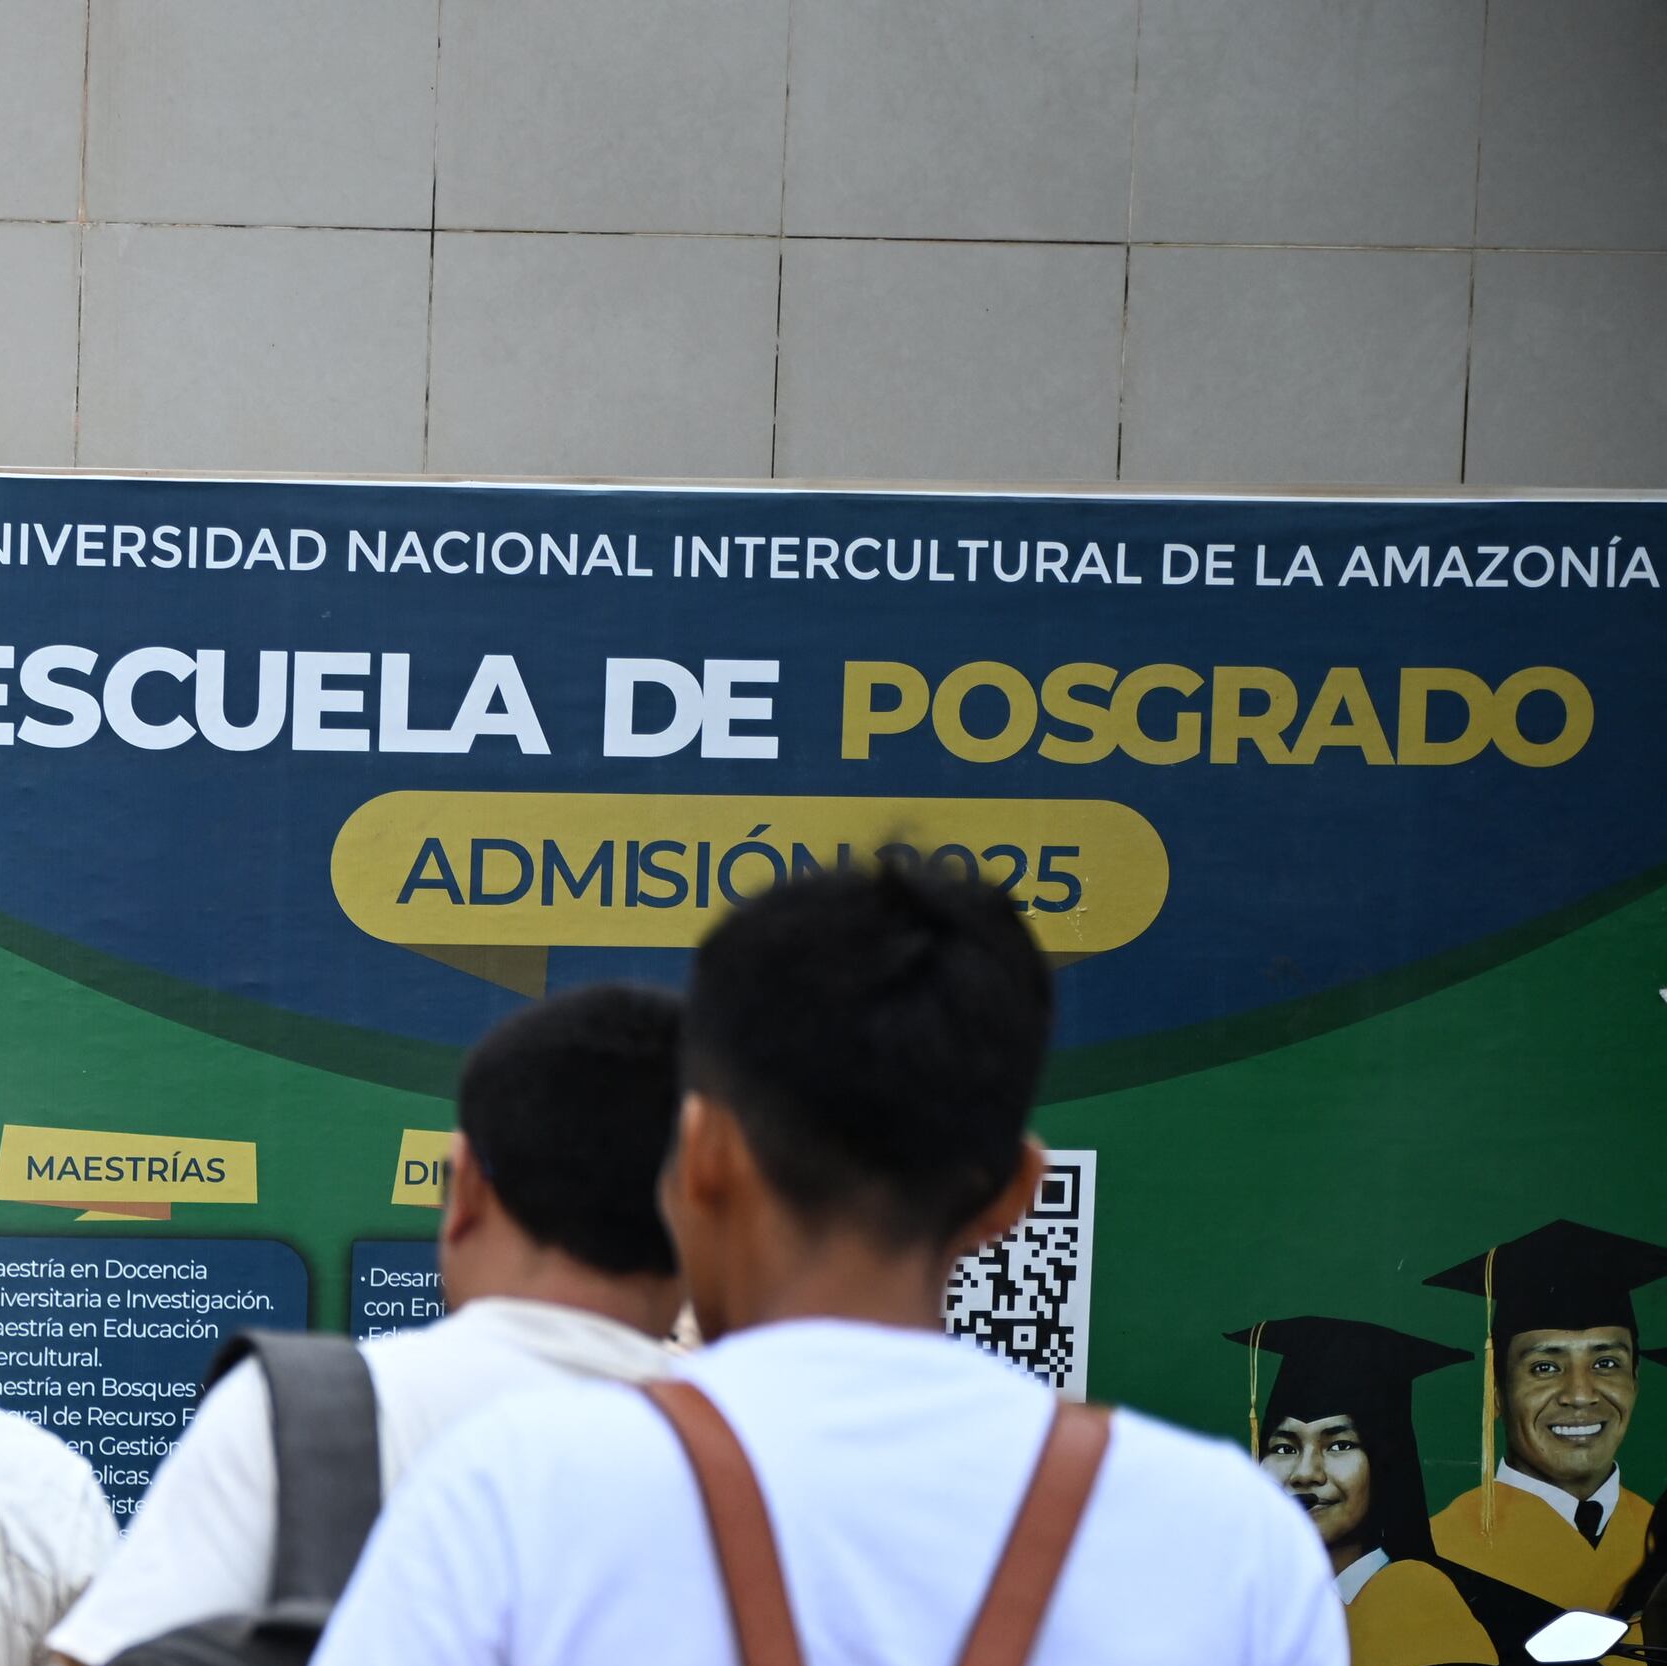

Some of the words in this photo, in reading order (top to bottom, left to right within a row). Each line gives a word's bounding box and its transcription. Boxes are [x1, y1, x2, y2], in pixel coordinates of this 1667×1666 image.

[347, 527, 653, 579] NACIONAL
[672, 534, 1141, 585] INTERCULTURAL
[1163, 542, 1235, 586] DE
[1257, 543, 1323, 588] LA
[1338, 535, 1660, 588] AMAZONÍA
[603, 657, 779, 759] DE
[841, 660, 1595, 768] POSGRADO
[27, 1151, 226, 1183] MAESTRÍAS
[70, 1263, 99, 1279] en
[105, 1259, 207, 1280] Docencia
[107, 1294, 121, 1308] e
[126, 1289, 274, 1315] Investigación.
[364, 1301, 404, 1316] con
[68, 1322, 99, 1338] en
[104, 1318, 218, 1340] Educación
[67, 1381, 95, 1397] en
[102, 1377, 197, 1402] Bosques
[53, 1406, 82, 1426] de
[87, 1406, 176, 1427] Recurso
[67, 1439, 94, 1456] en
